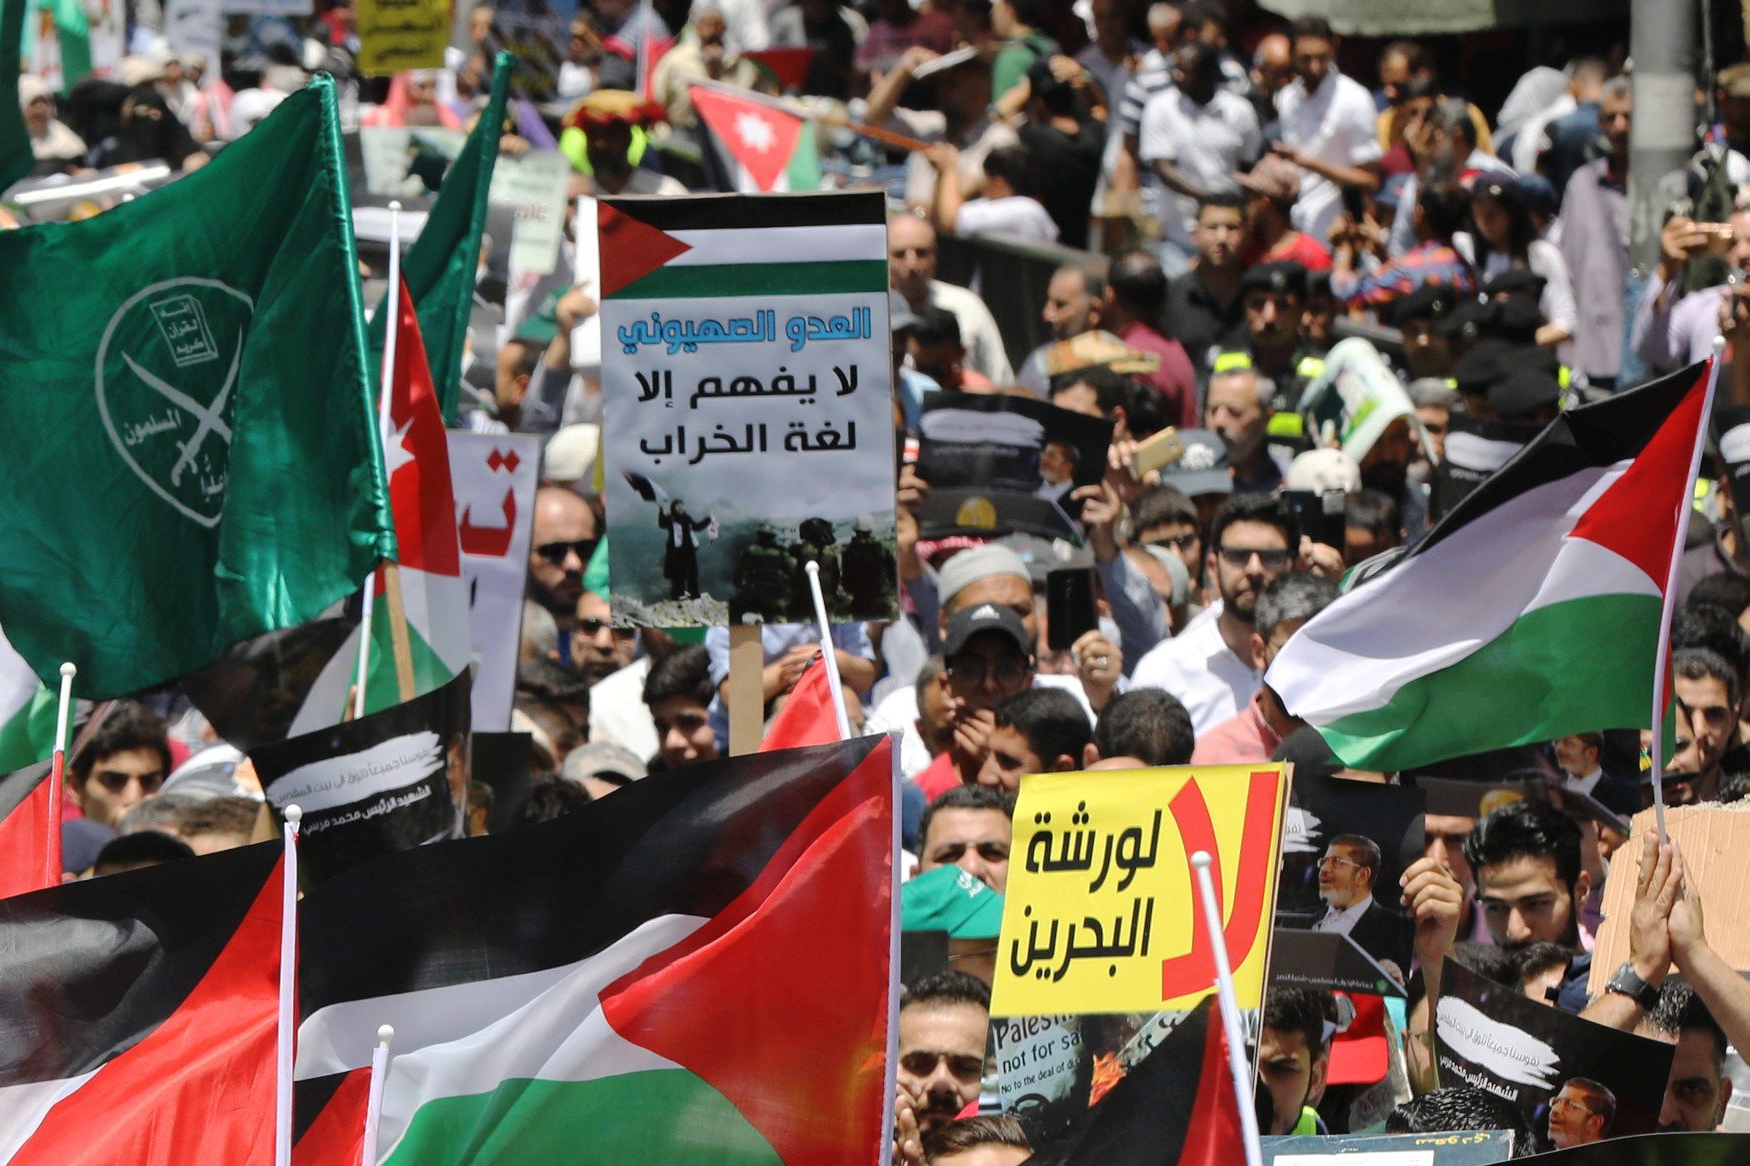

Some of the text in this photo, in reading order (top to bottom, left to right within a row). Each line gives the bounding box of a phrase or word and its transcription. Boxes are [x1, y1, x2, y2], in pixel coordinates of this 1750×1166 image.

[618, 305, 871, 355] العدو الصهيوني
[634, 364, 858, 409] لا يفهم إلا
[640, 421, 856, 465] لغة الخراب
[1025, 800, 1162, 893] لورشة
[1161, 770, 1280, 1002] لا
[1010, 897, 1155, 983] البحرين
[997, 1014, 1073, 1050] Pales
[1002, 1050, 1026, 1074] not
[1032, 1040, 1055, 1062] for
[1024, 1073, 1036, 1087] the
